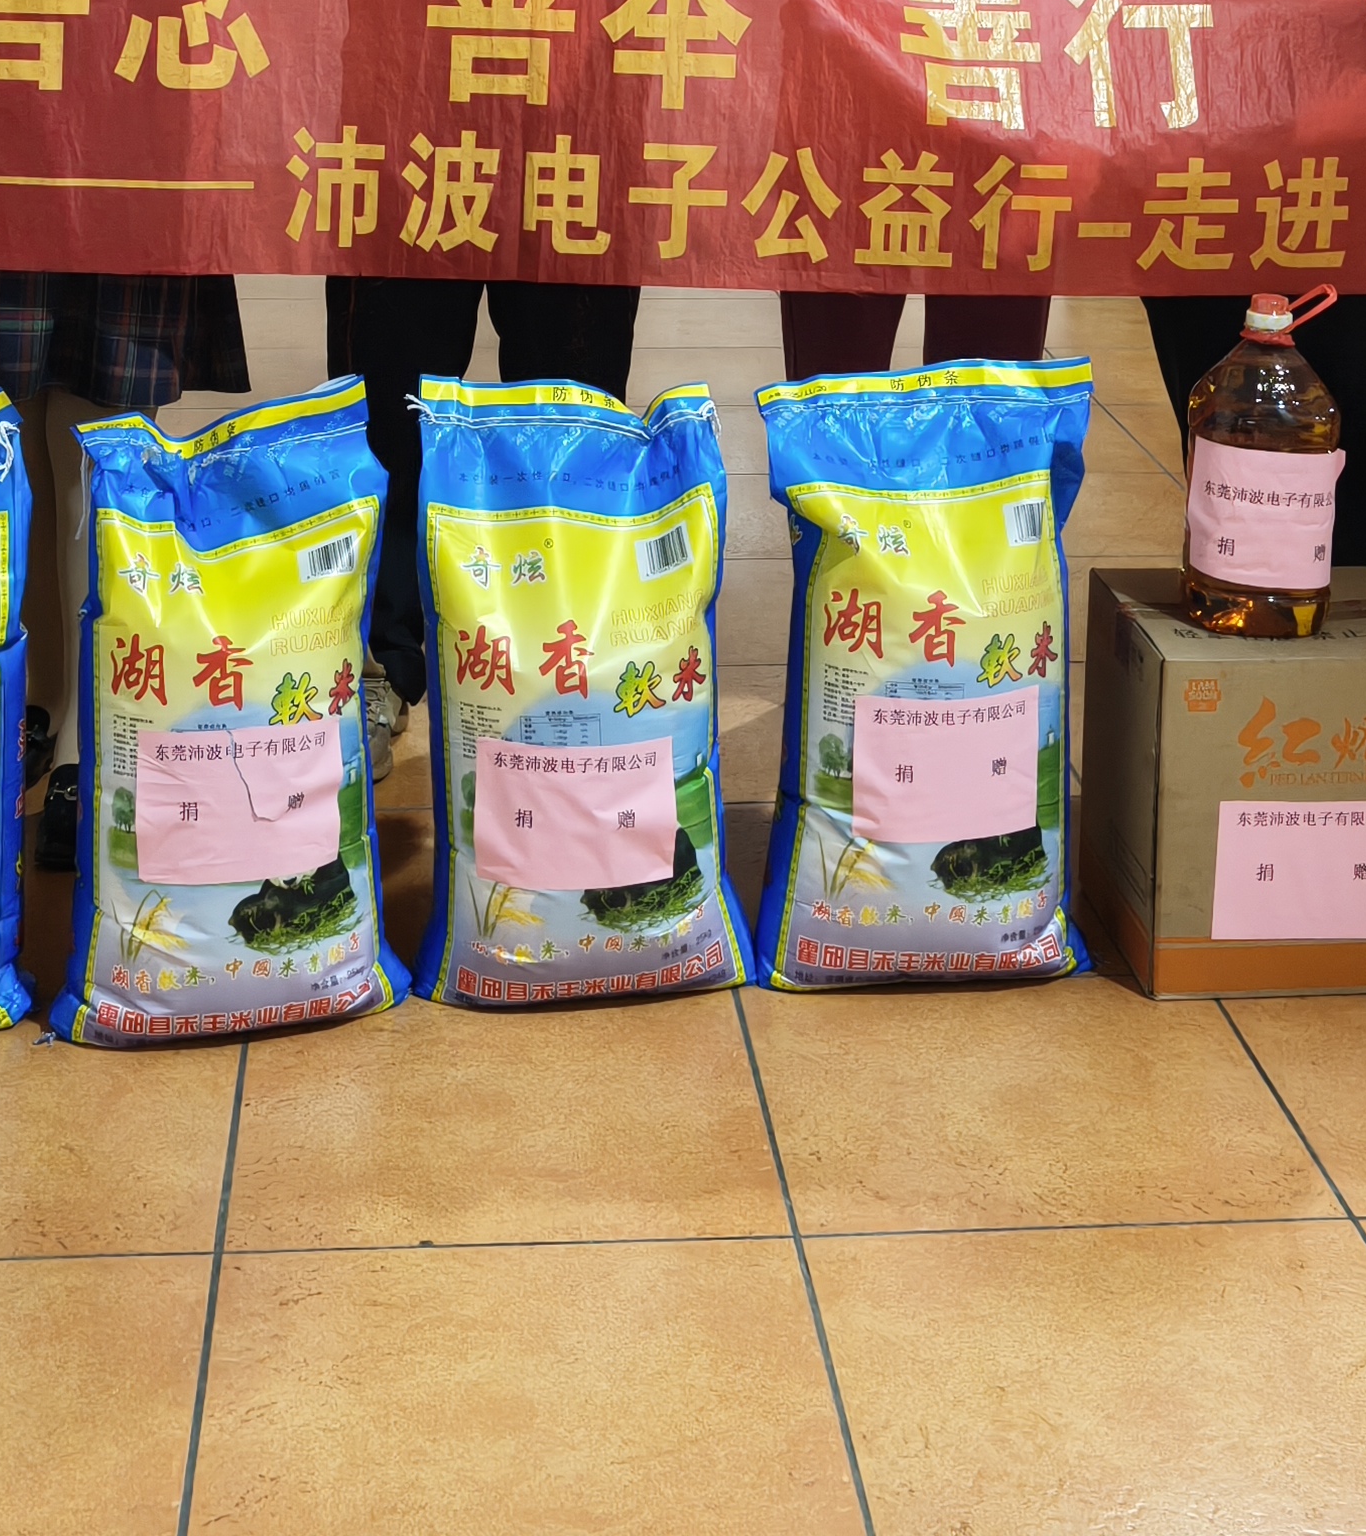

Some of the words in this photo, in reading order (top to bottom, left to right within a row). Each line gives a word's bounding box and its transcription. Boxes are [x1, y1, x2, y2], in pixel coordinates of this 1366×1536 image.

[1217, 537, 1235, 556] 捐
[1313, 543, 1327, 563] 赠
[873, 700, 1026, 727] 东莞沛波电子有限公司
[494, 751, 658, 774] 东莞沛波电子有限公司
[895, 764, 914, 783] 捐
[991, 757, 1008, 777] 赠
[179, 802, 199, 821] 捐
[515, 809, 534, 829] 捐
[617, 809, 636, 831] 赠
[1256, 863, 1275, 882] 捐
